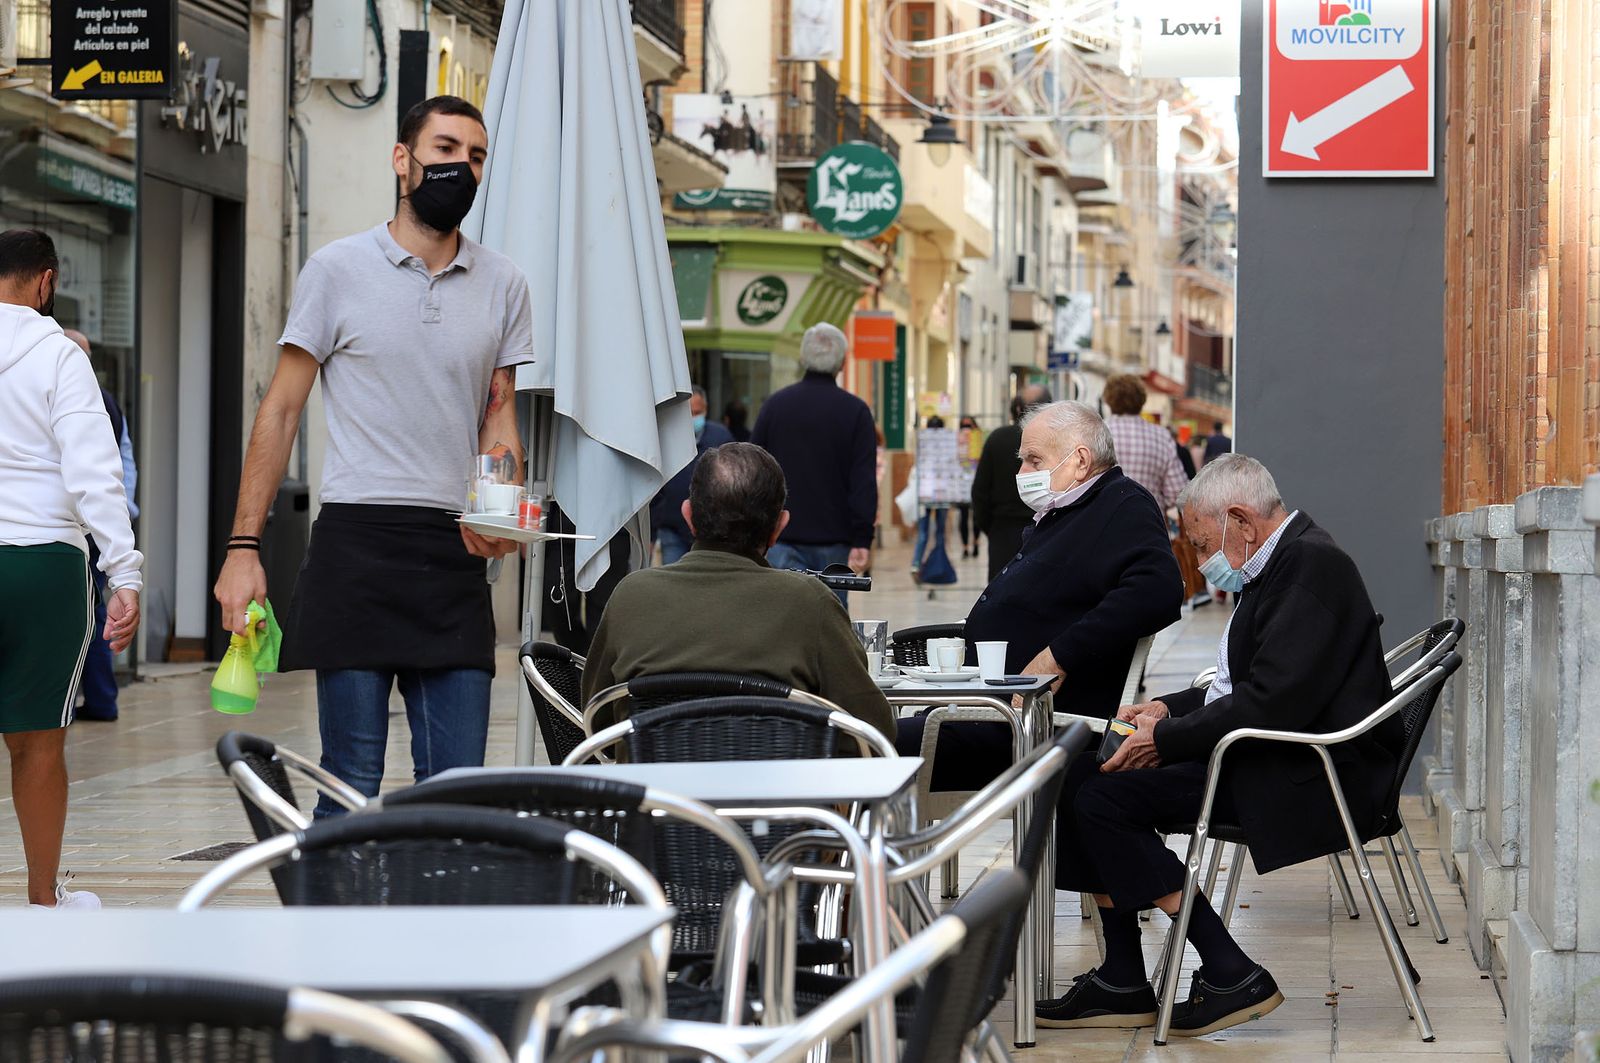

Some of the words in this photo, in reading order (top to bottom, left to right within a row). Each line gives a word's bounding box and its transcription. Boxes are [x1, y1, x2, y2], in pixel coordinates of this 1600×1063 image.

[76, 7, 111, 21] Arreglo
[113, 9, 119, 20] y
[120, 8, 147, 18] venta
[84, 23, 101, 34] del
[102, 23, 139, 34] calzado
[1160, 16, 1222, 36] Lowi
[1291, 28, 1405, 44] MOVILCITY
[74, 38, 115, 51] Artículos
[116, 41, 129, 50] en
[130, 38, 149, 52] piel
[100, 71, 115, 83] EN
[117, 70, 163, 84] GALERIA
